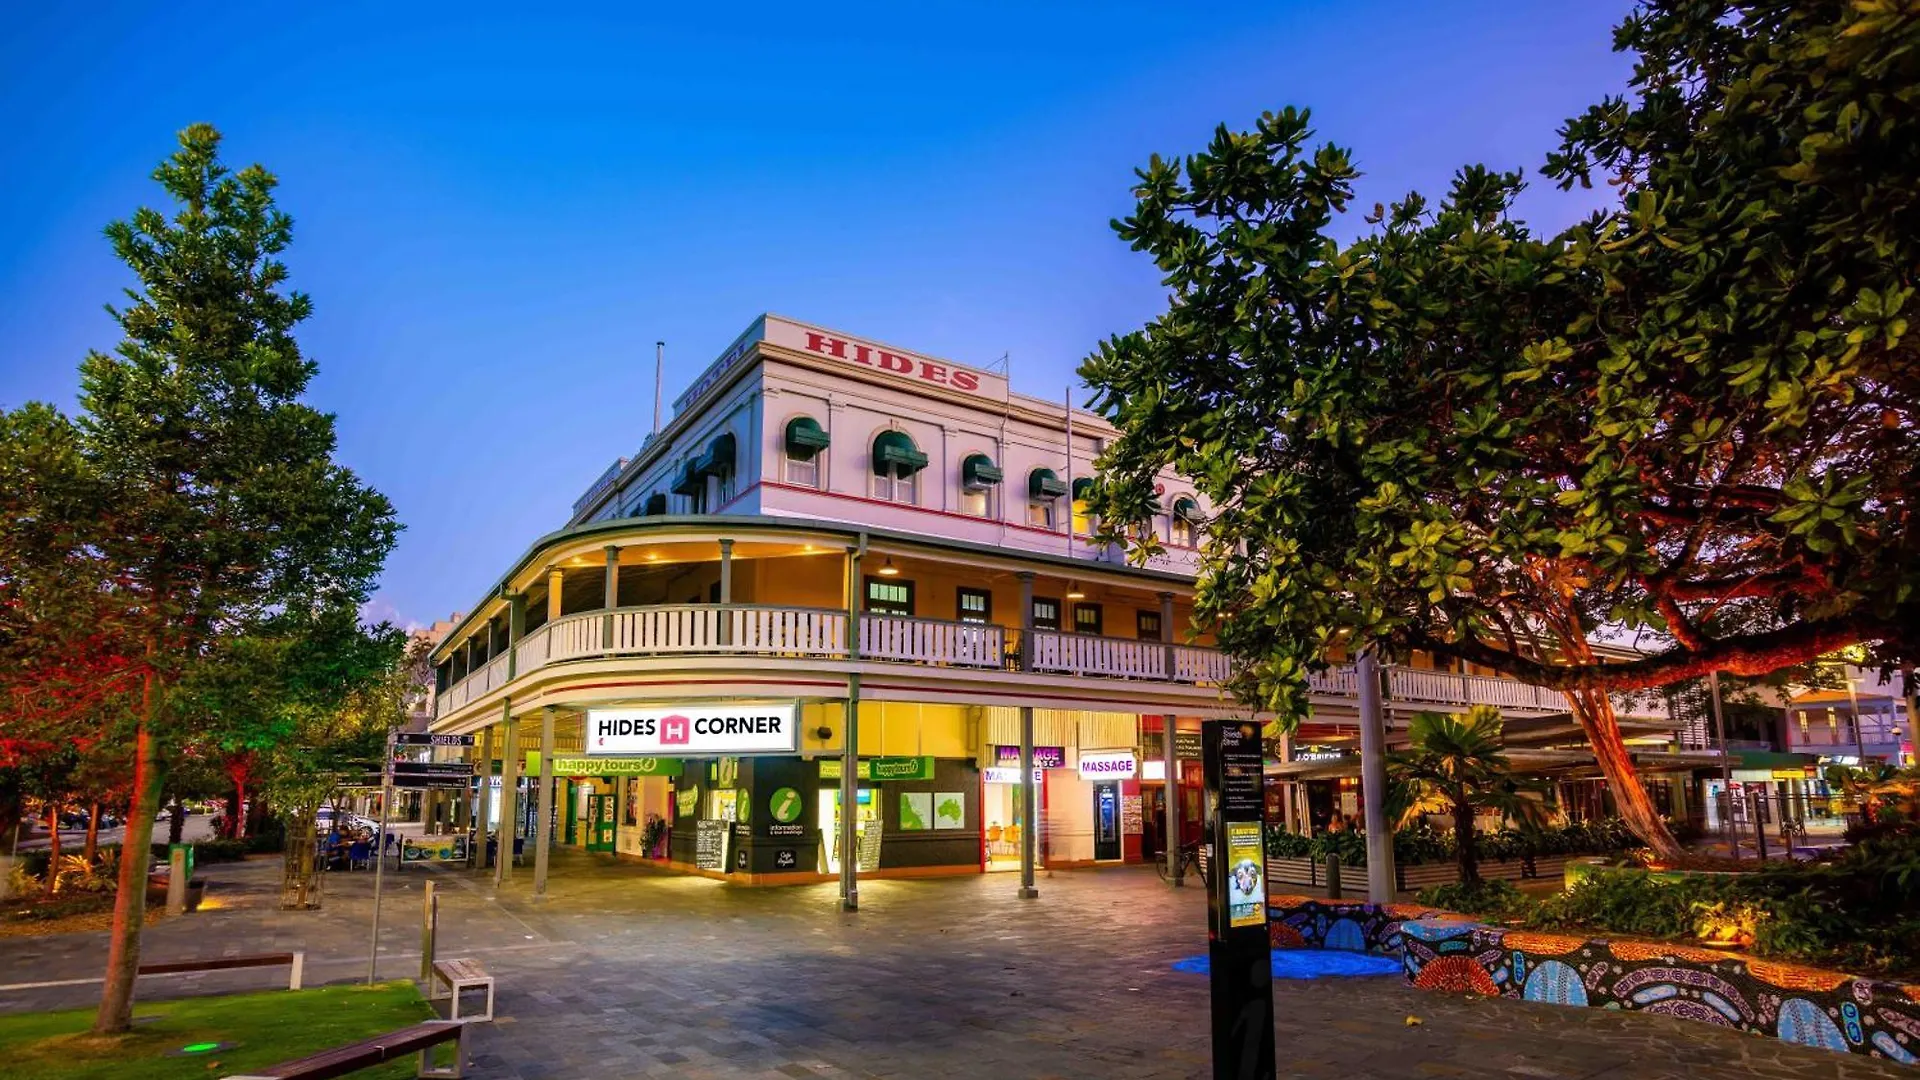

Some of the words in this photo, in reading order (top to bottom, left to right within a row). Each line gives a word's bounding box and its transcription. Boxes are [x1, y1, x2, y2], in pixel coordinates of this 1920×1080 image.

[805, 332, 980, 391] HIDES
[598, 718, 656, 736] HIDES
[695, 716, 781, 735] CORNER
[430, 734, 462, 745] SHIELDS
[1000, 747, 1060, 760] MAAGE
[1082, 760, 1133, 772] MASSAGE
